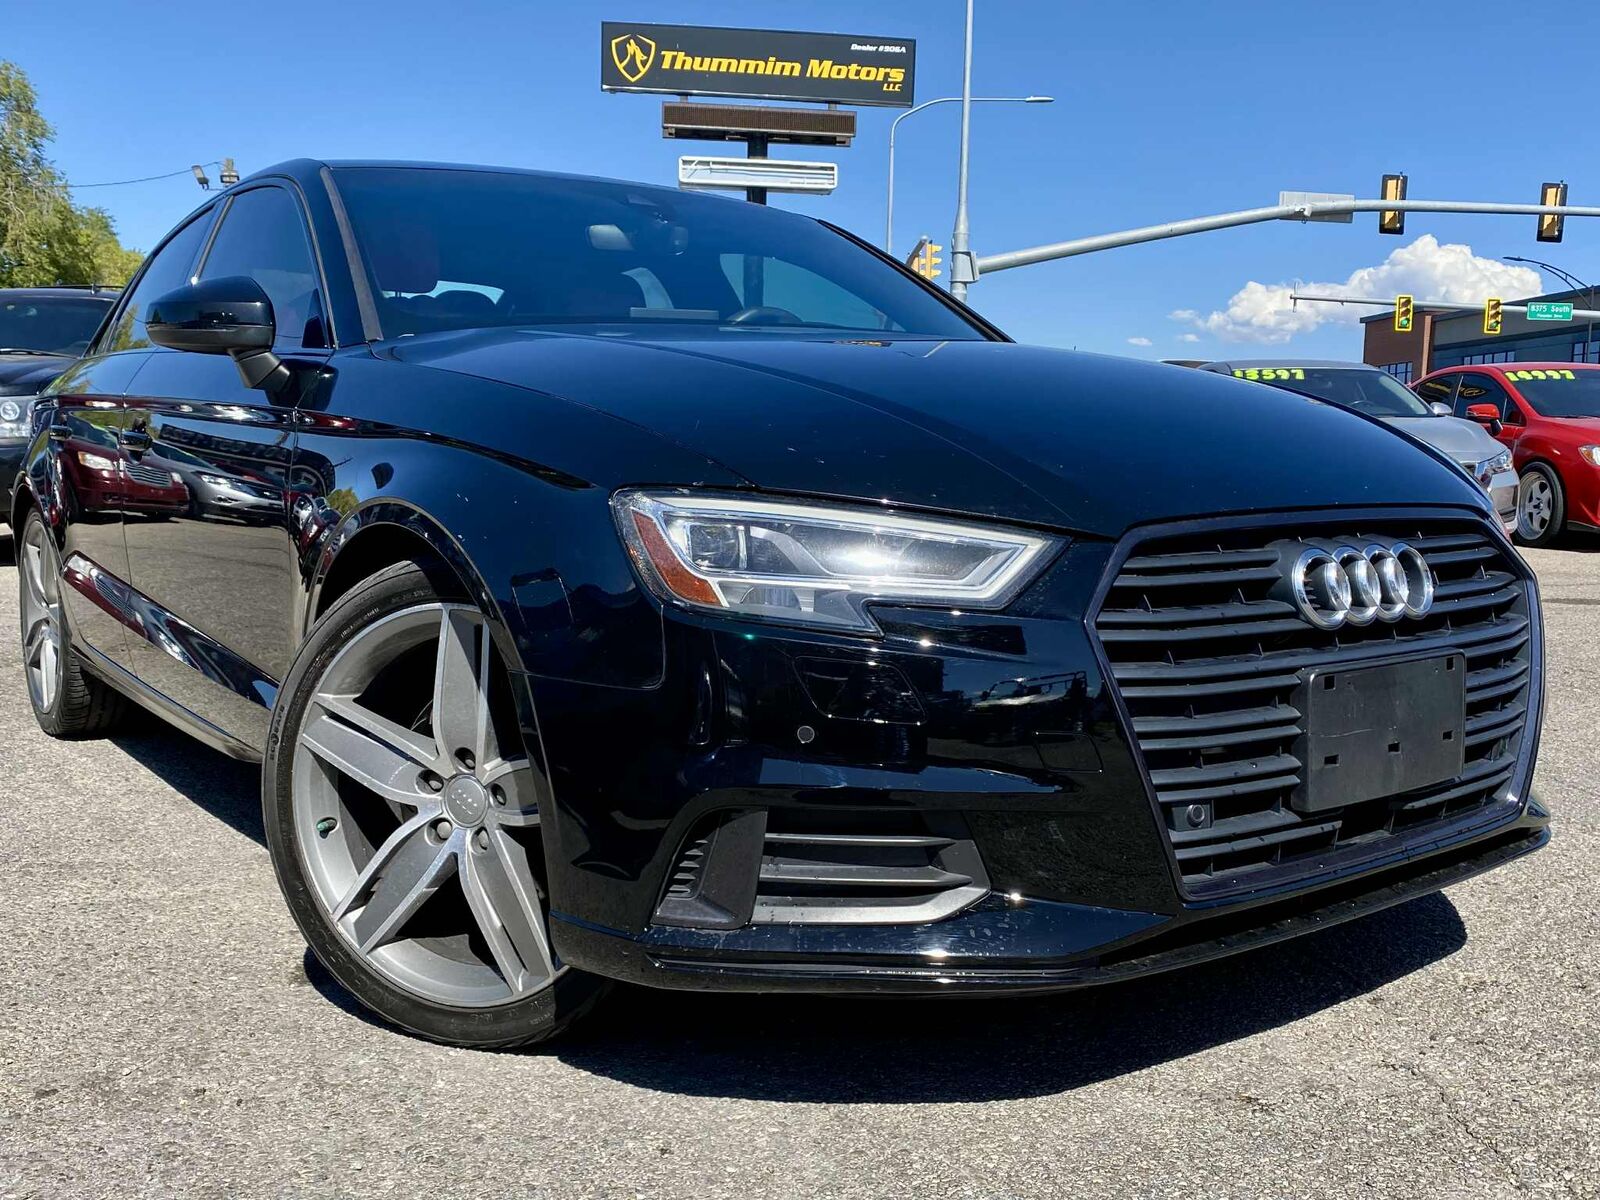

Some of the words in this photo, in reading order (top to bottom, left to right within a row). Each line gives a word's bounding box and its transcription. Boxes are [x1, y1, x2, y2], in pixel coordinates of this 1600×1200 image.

[851, 43, 878, 51] Dealer
[661, 50, 801, 77] Thummim
[806, 59, 905, 82] Motors
[883, 83, 902, 91] LLC
[1550, 304, 1570, 313] South
